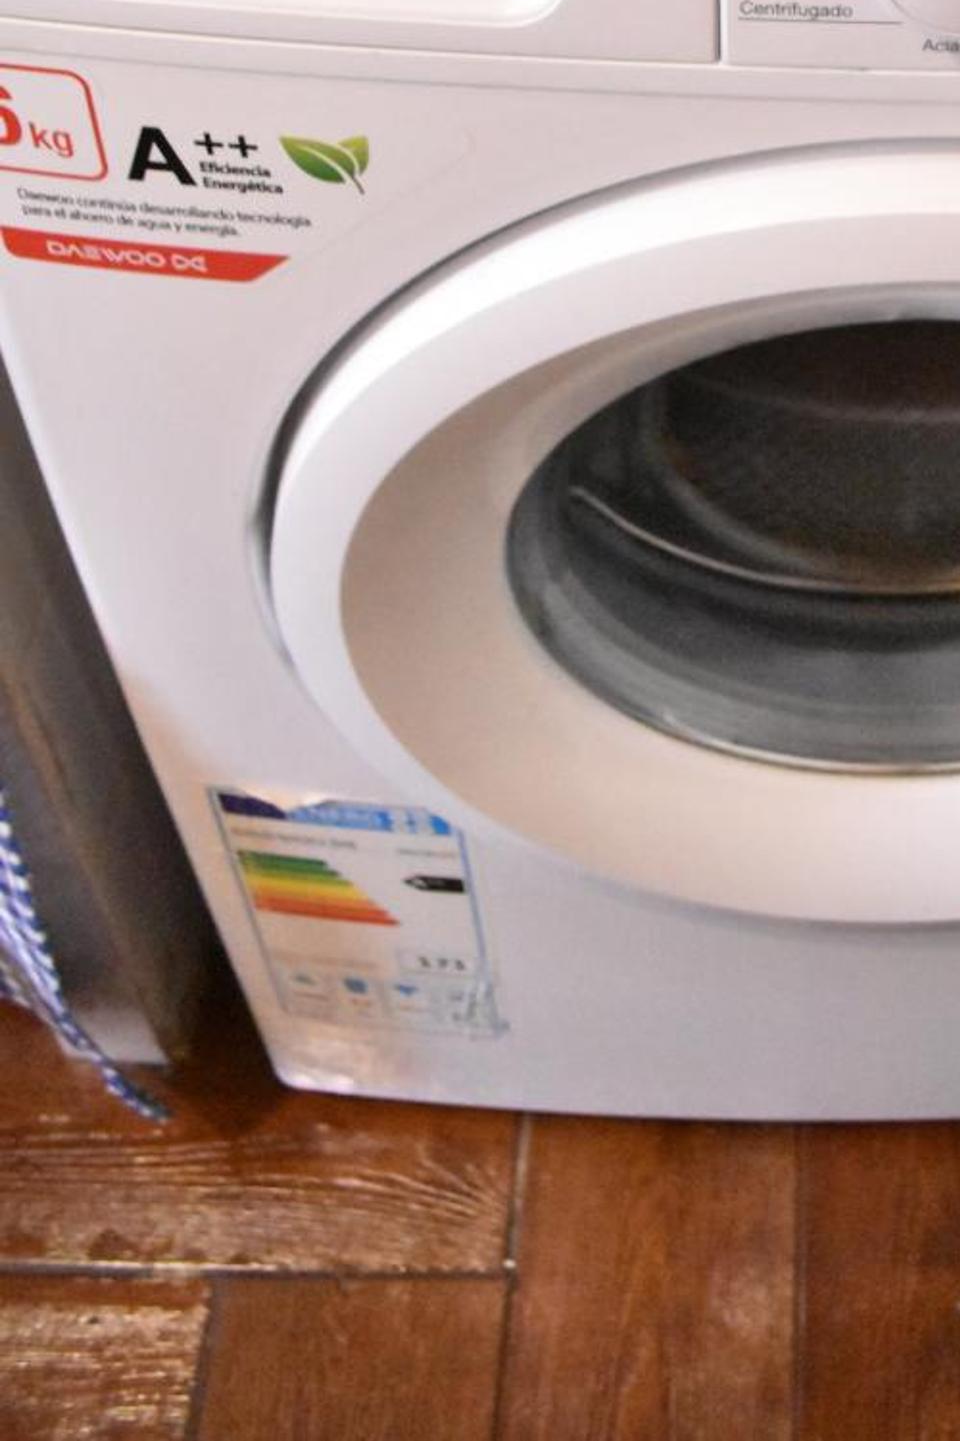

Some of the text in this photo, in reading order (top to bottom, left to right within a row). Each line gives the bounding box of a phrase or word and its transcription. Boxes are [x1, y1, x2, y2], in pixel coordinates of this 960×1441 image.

[127, 125, 259, 187] A++
[199, 160, 272, 179] Eficiencia
[202, 176, 284, 195] Energética
[46, 239, 167, 268] DAEWOO
